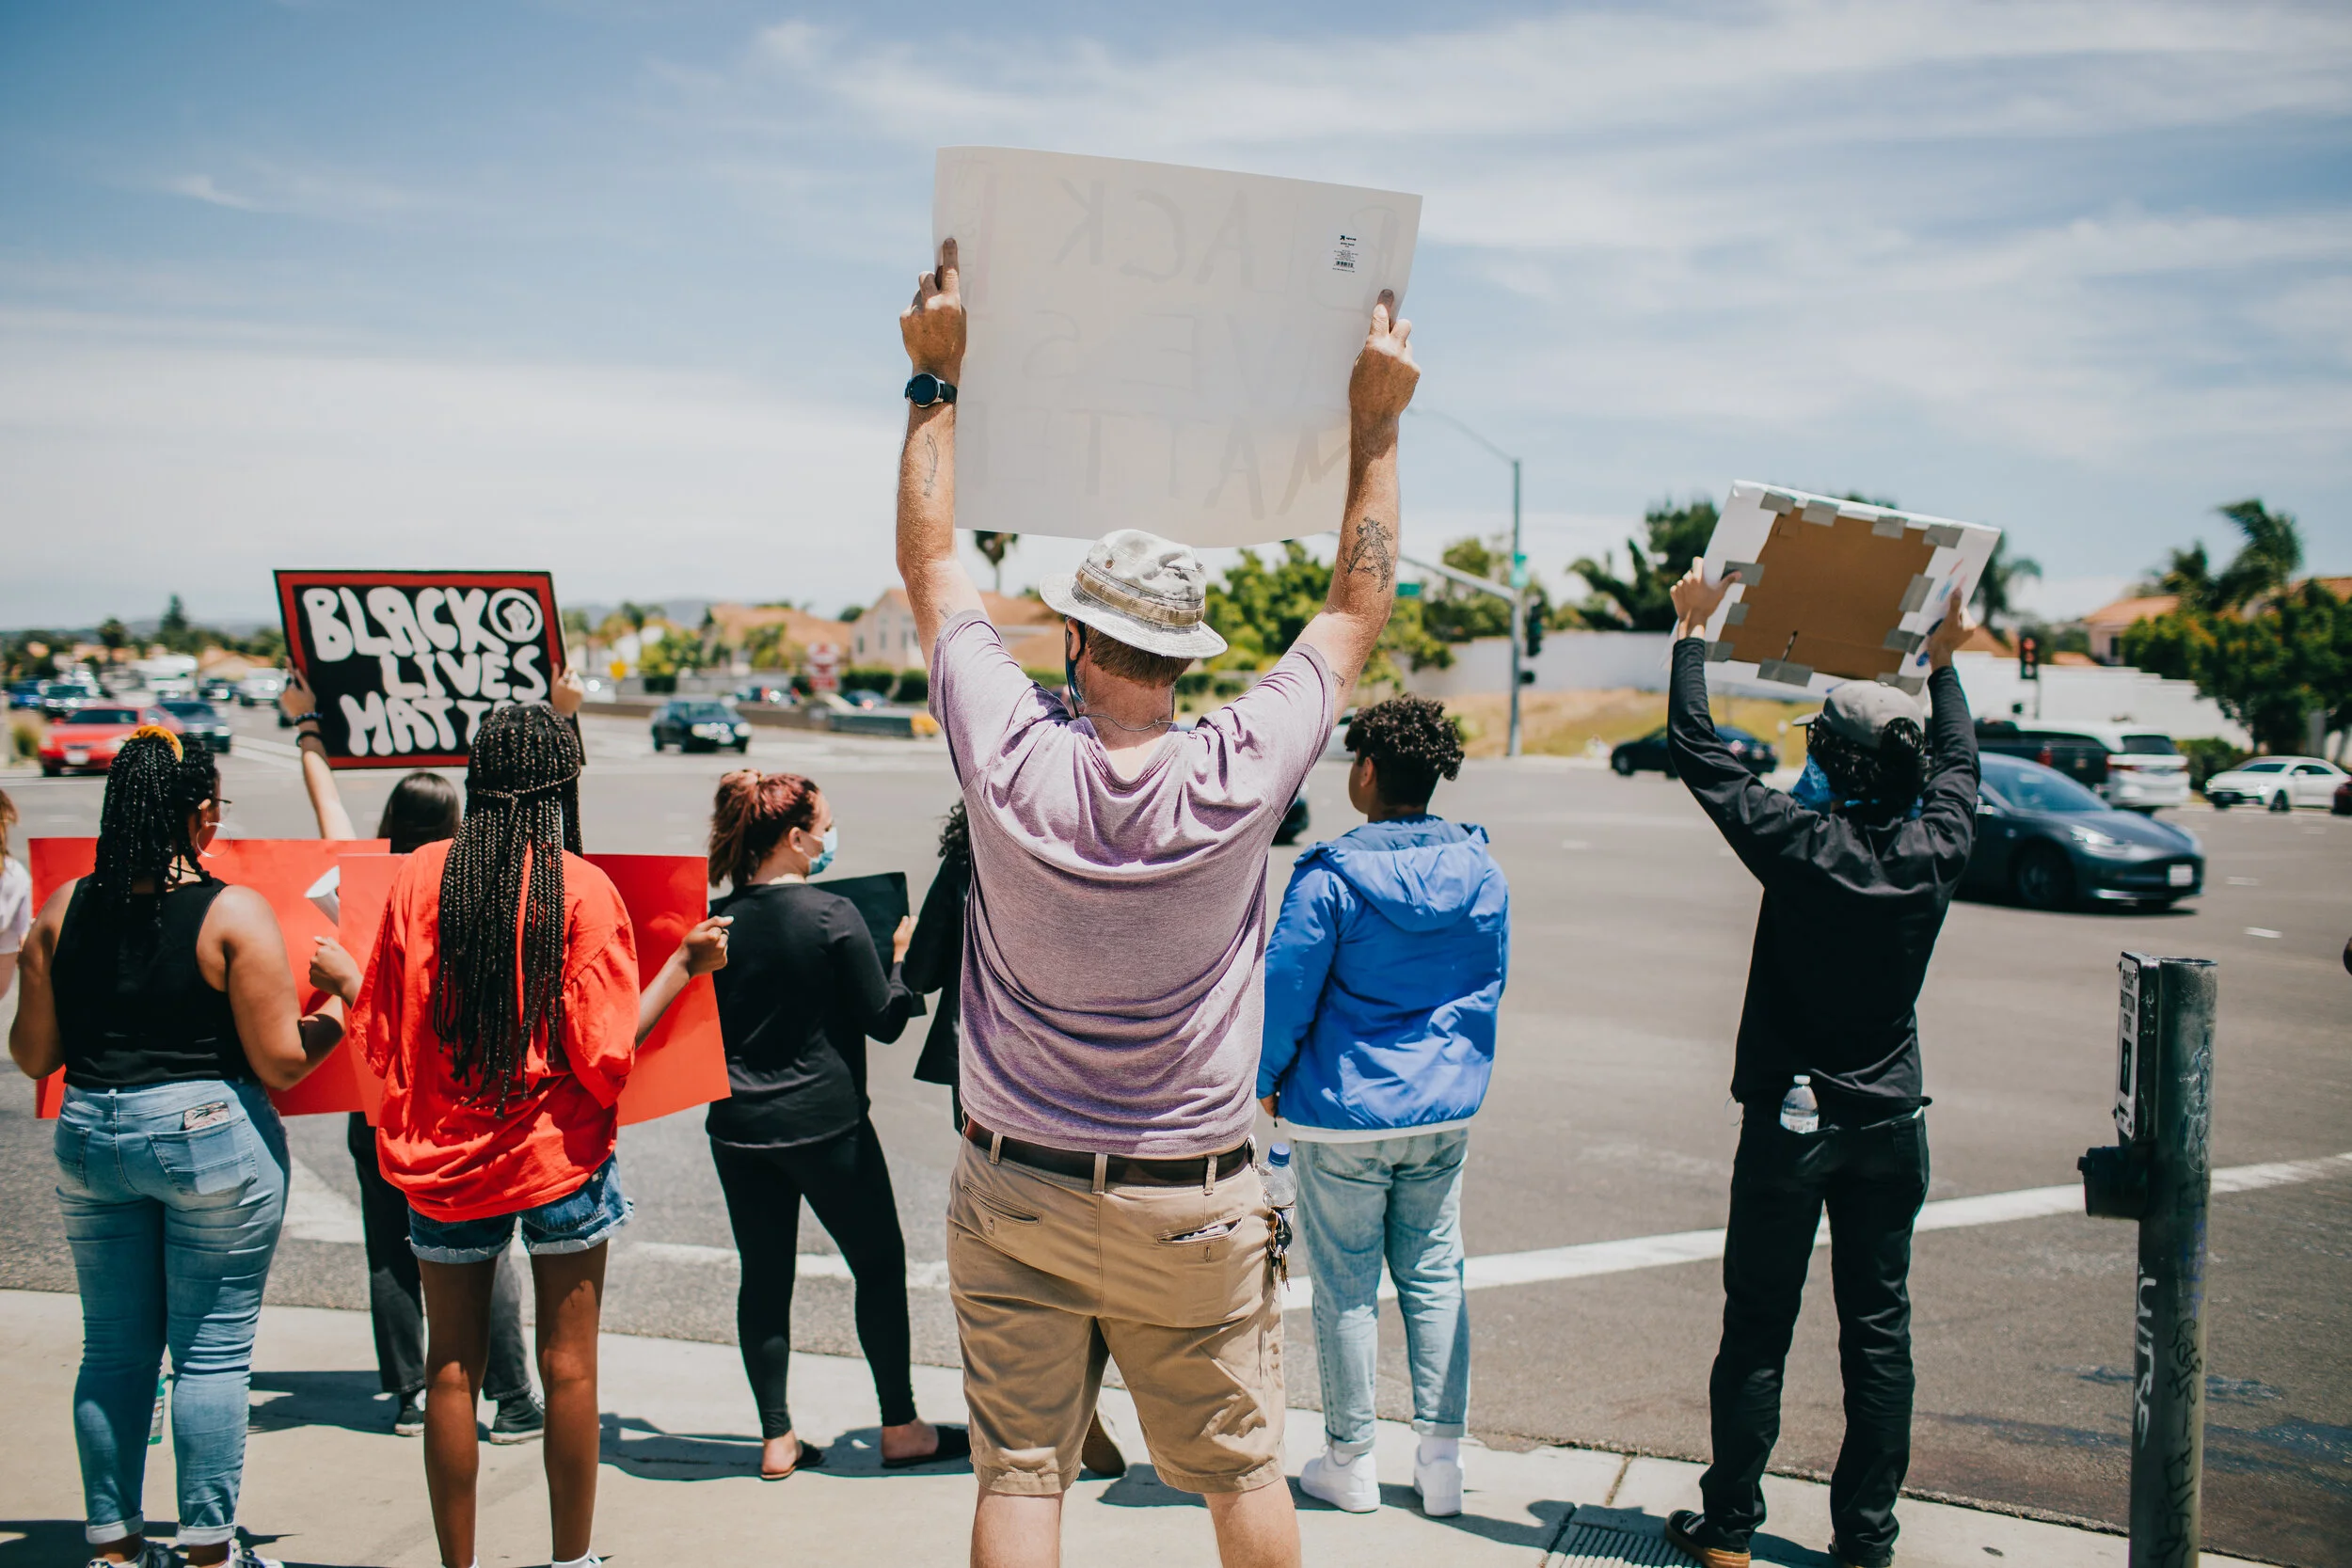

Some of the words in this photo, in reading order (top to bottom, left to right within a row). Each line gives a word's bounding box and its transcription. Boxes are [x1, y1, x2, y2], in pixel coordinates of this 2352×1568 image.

[303, 586, 508, 661] BLACK
[379, 644, 548, 702] LIVES
[340, 690, 552, 756] MATT
